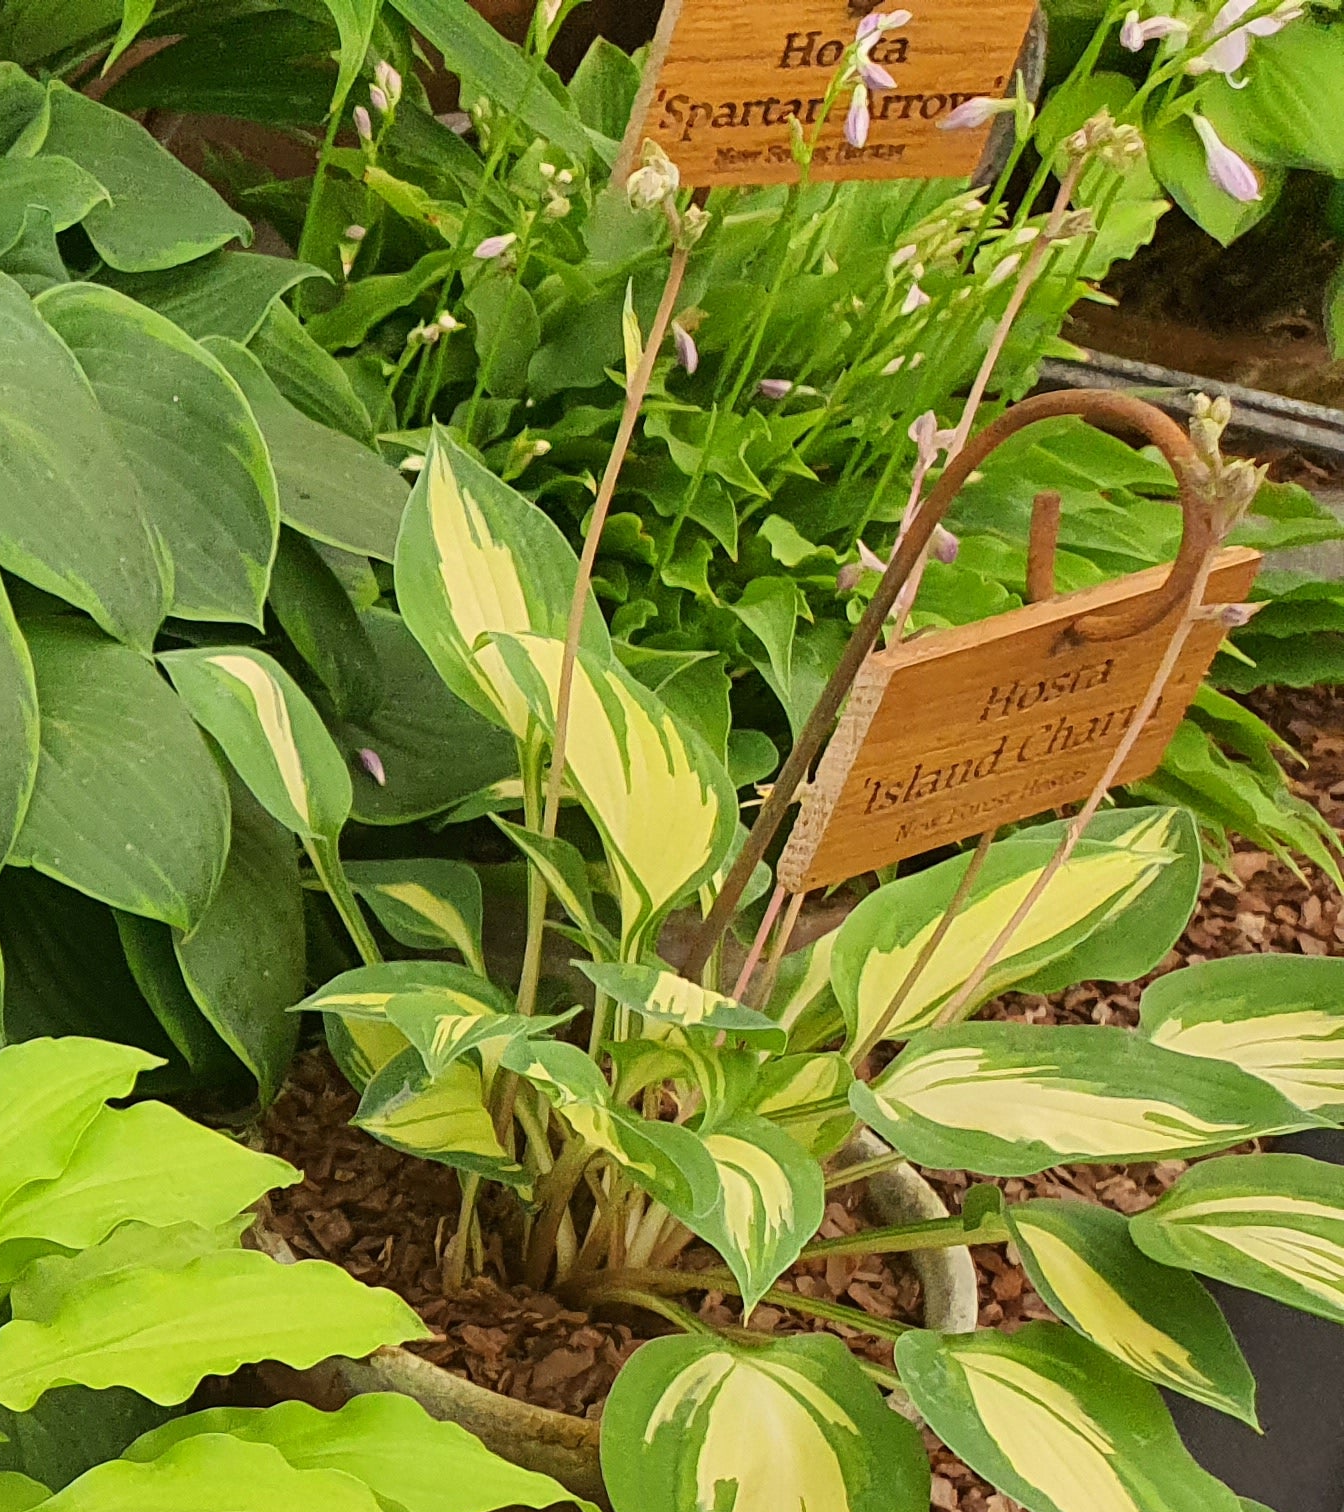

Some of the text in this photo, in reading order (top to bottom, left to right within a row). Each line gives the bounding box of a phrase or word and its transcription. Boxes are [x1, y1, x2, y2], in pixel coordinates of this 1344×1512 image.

[779, 30, 910, 69] Hota
[858, 75, 1004, 121] rro'
[978, 658, 1115, 724] Hosta
